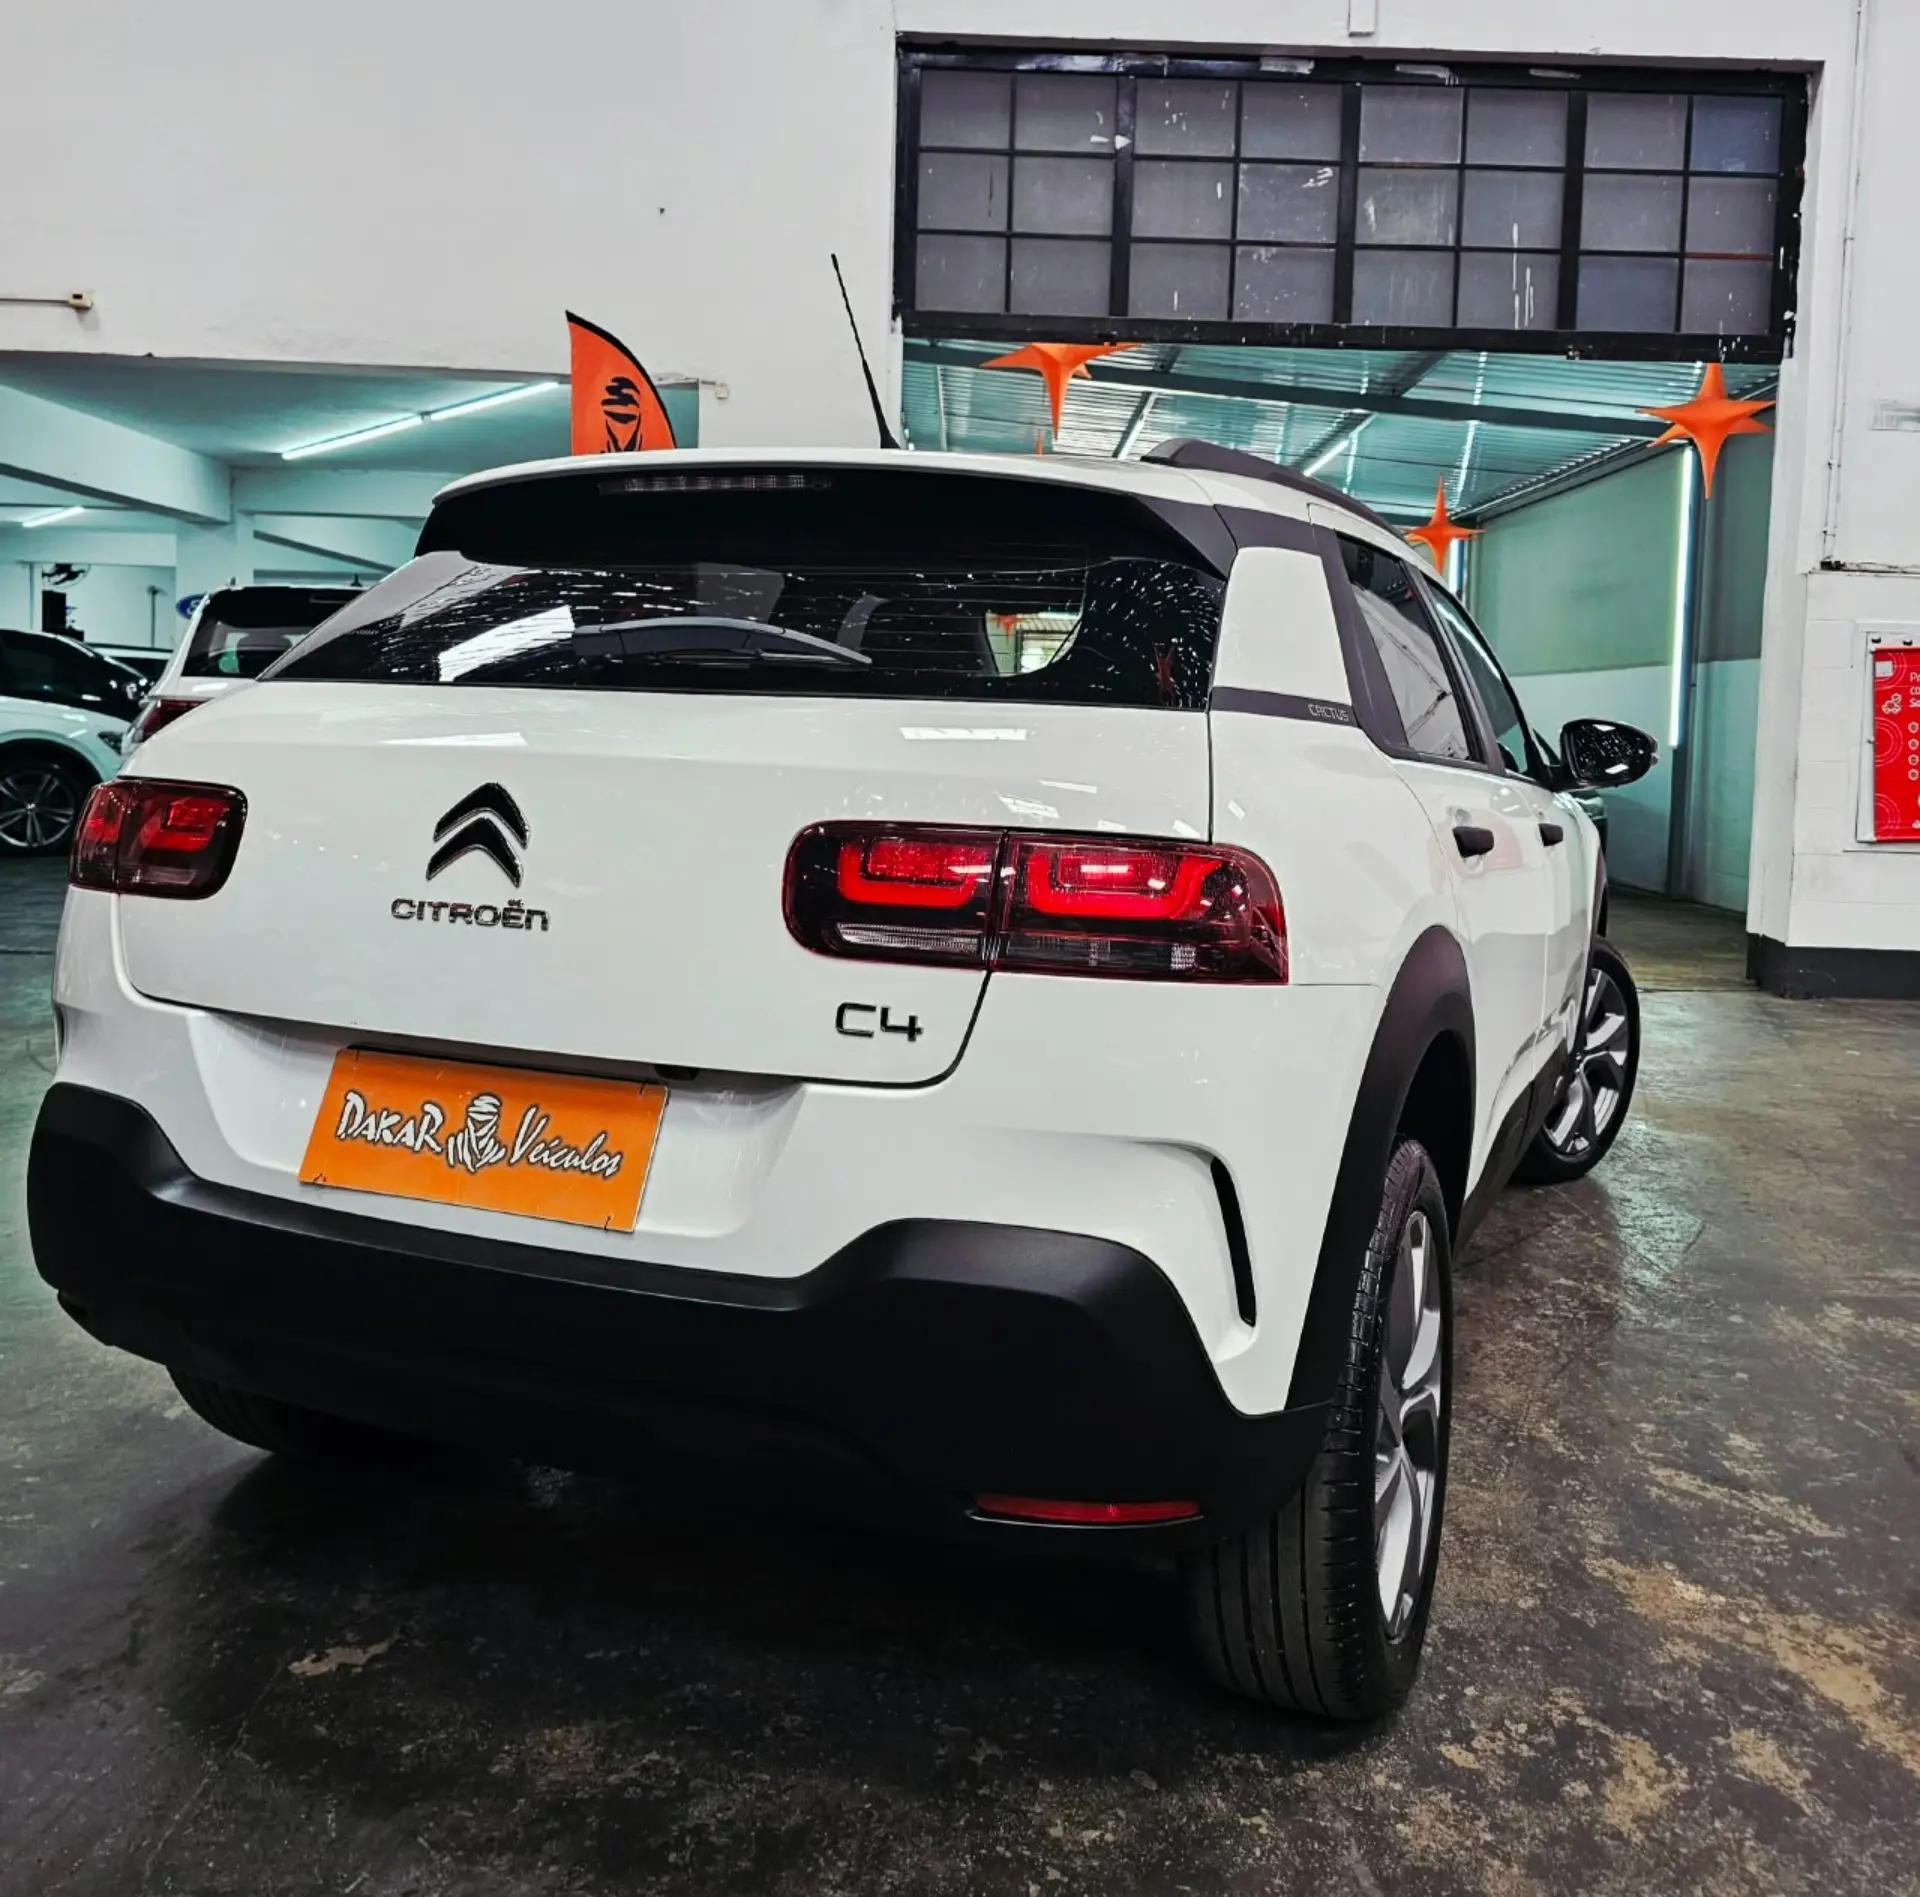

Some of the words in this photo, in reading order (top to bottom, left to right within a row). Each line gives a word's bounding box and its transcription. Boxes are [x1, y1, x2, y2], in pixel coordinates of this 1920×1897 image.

[1307, 703, 1349, 722] CACTUS
[835, 1001, 924, 1042] C4
[335, 1089, 443, 1154] DAKAR
[508, 1104, 623, 1178] Veículos
